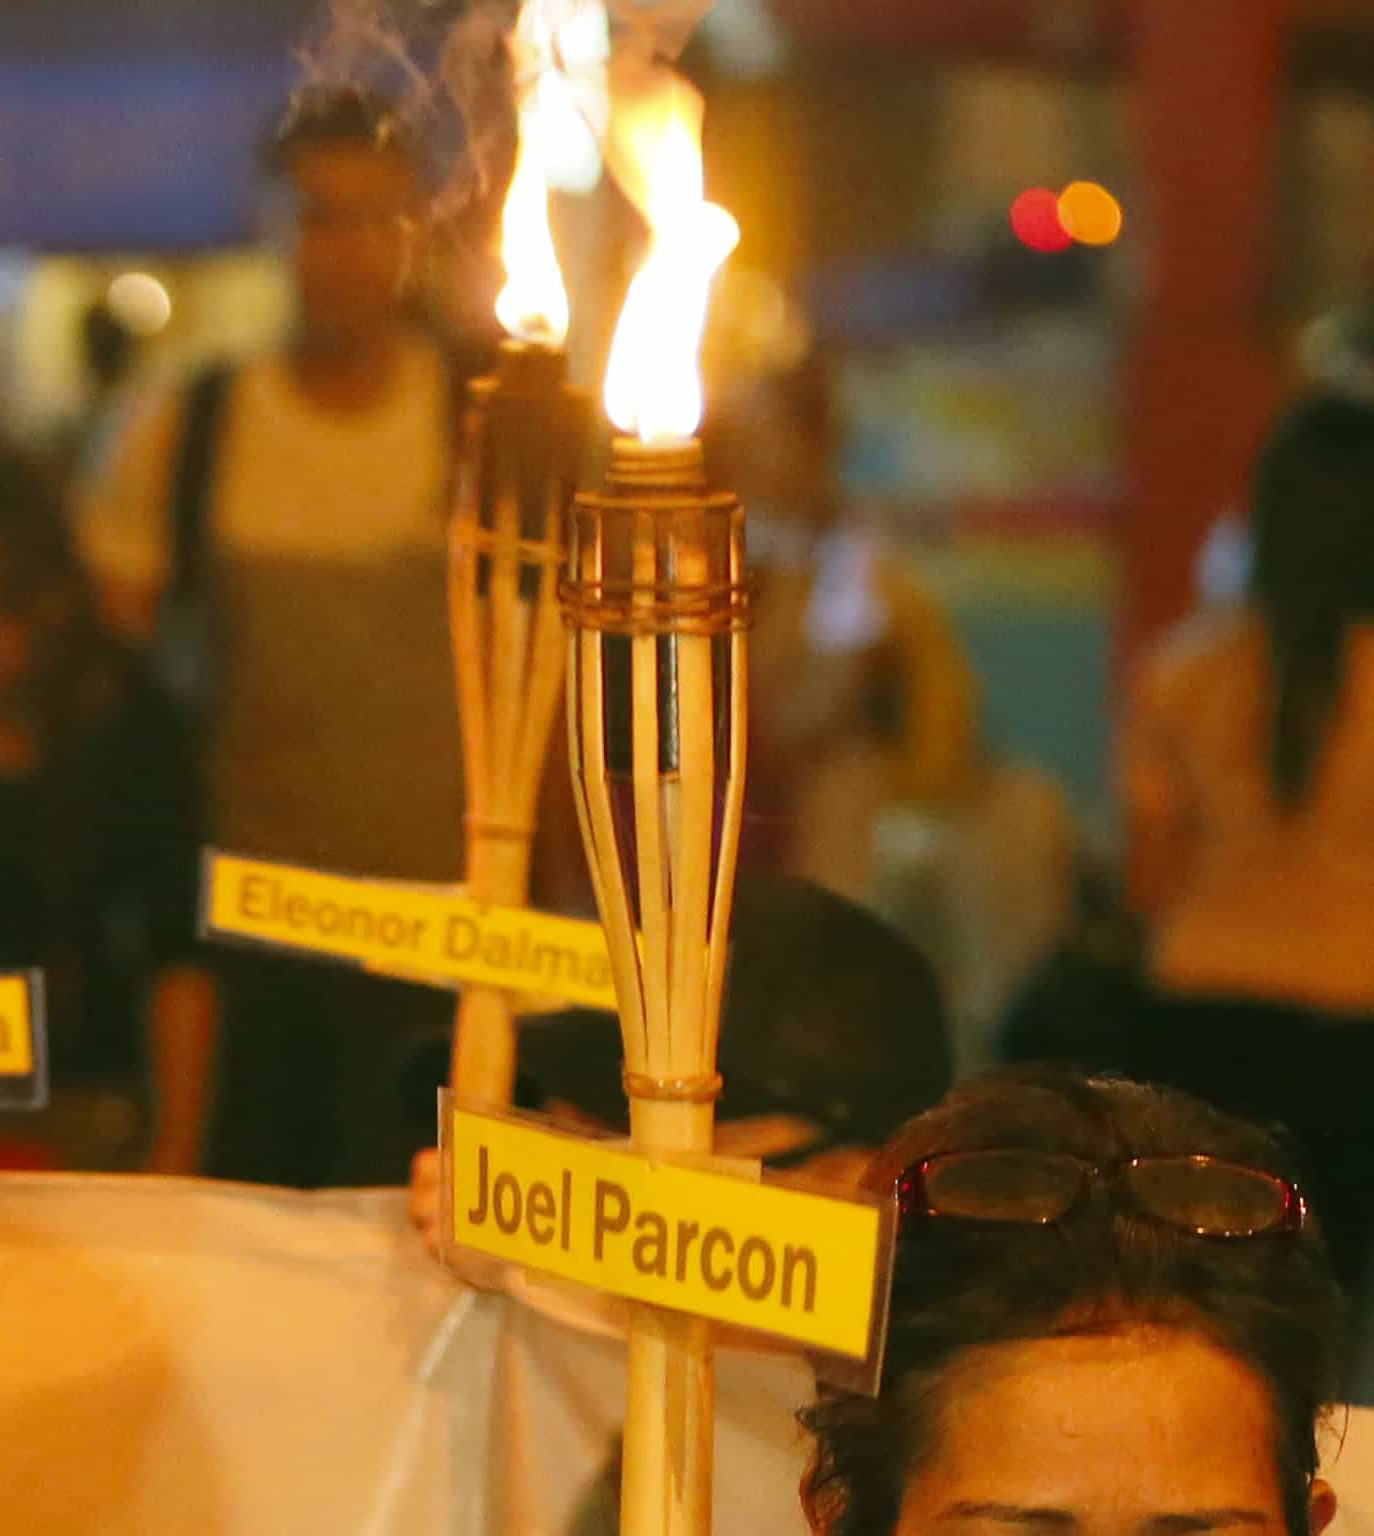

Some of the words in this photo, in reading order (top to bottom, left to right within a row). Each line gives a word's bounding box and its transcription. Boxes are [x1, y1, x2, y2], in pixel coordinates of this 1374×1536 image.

[236, 872, 428, 956] Eleonor
[467, 1145, 573, 1252] Joel
[593, 1180, 819, 1314] Parcon
